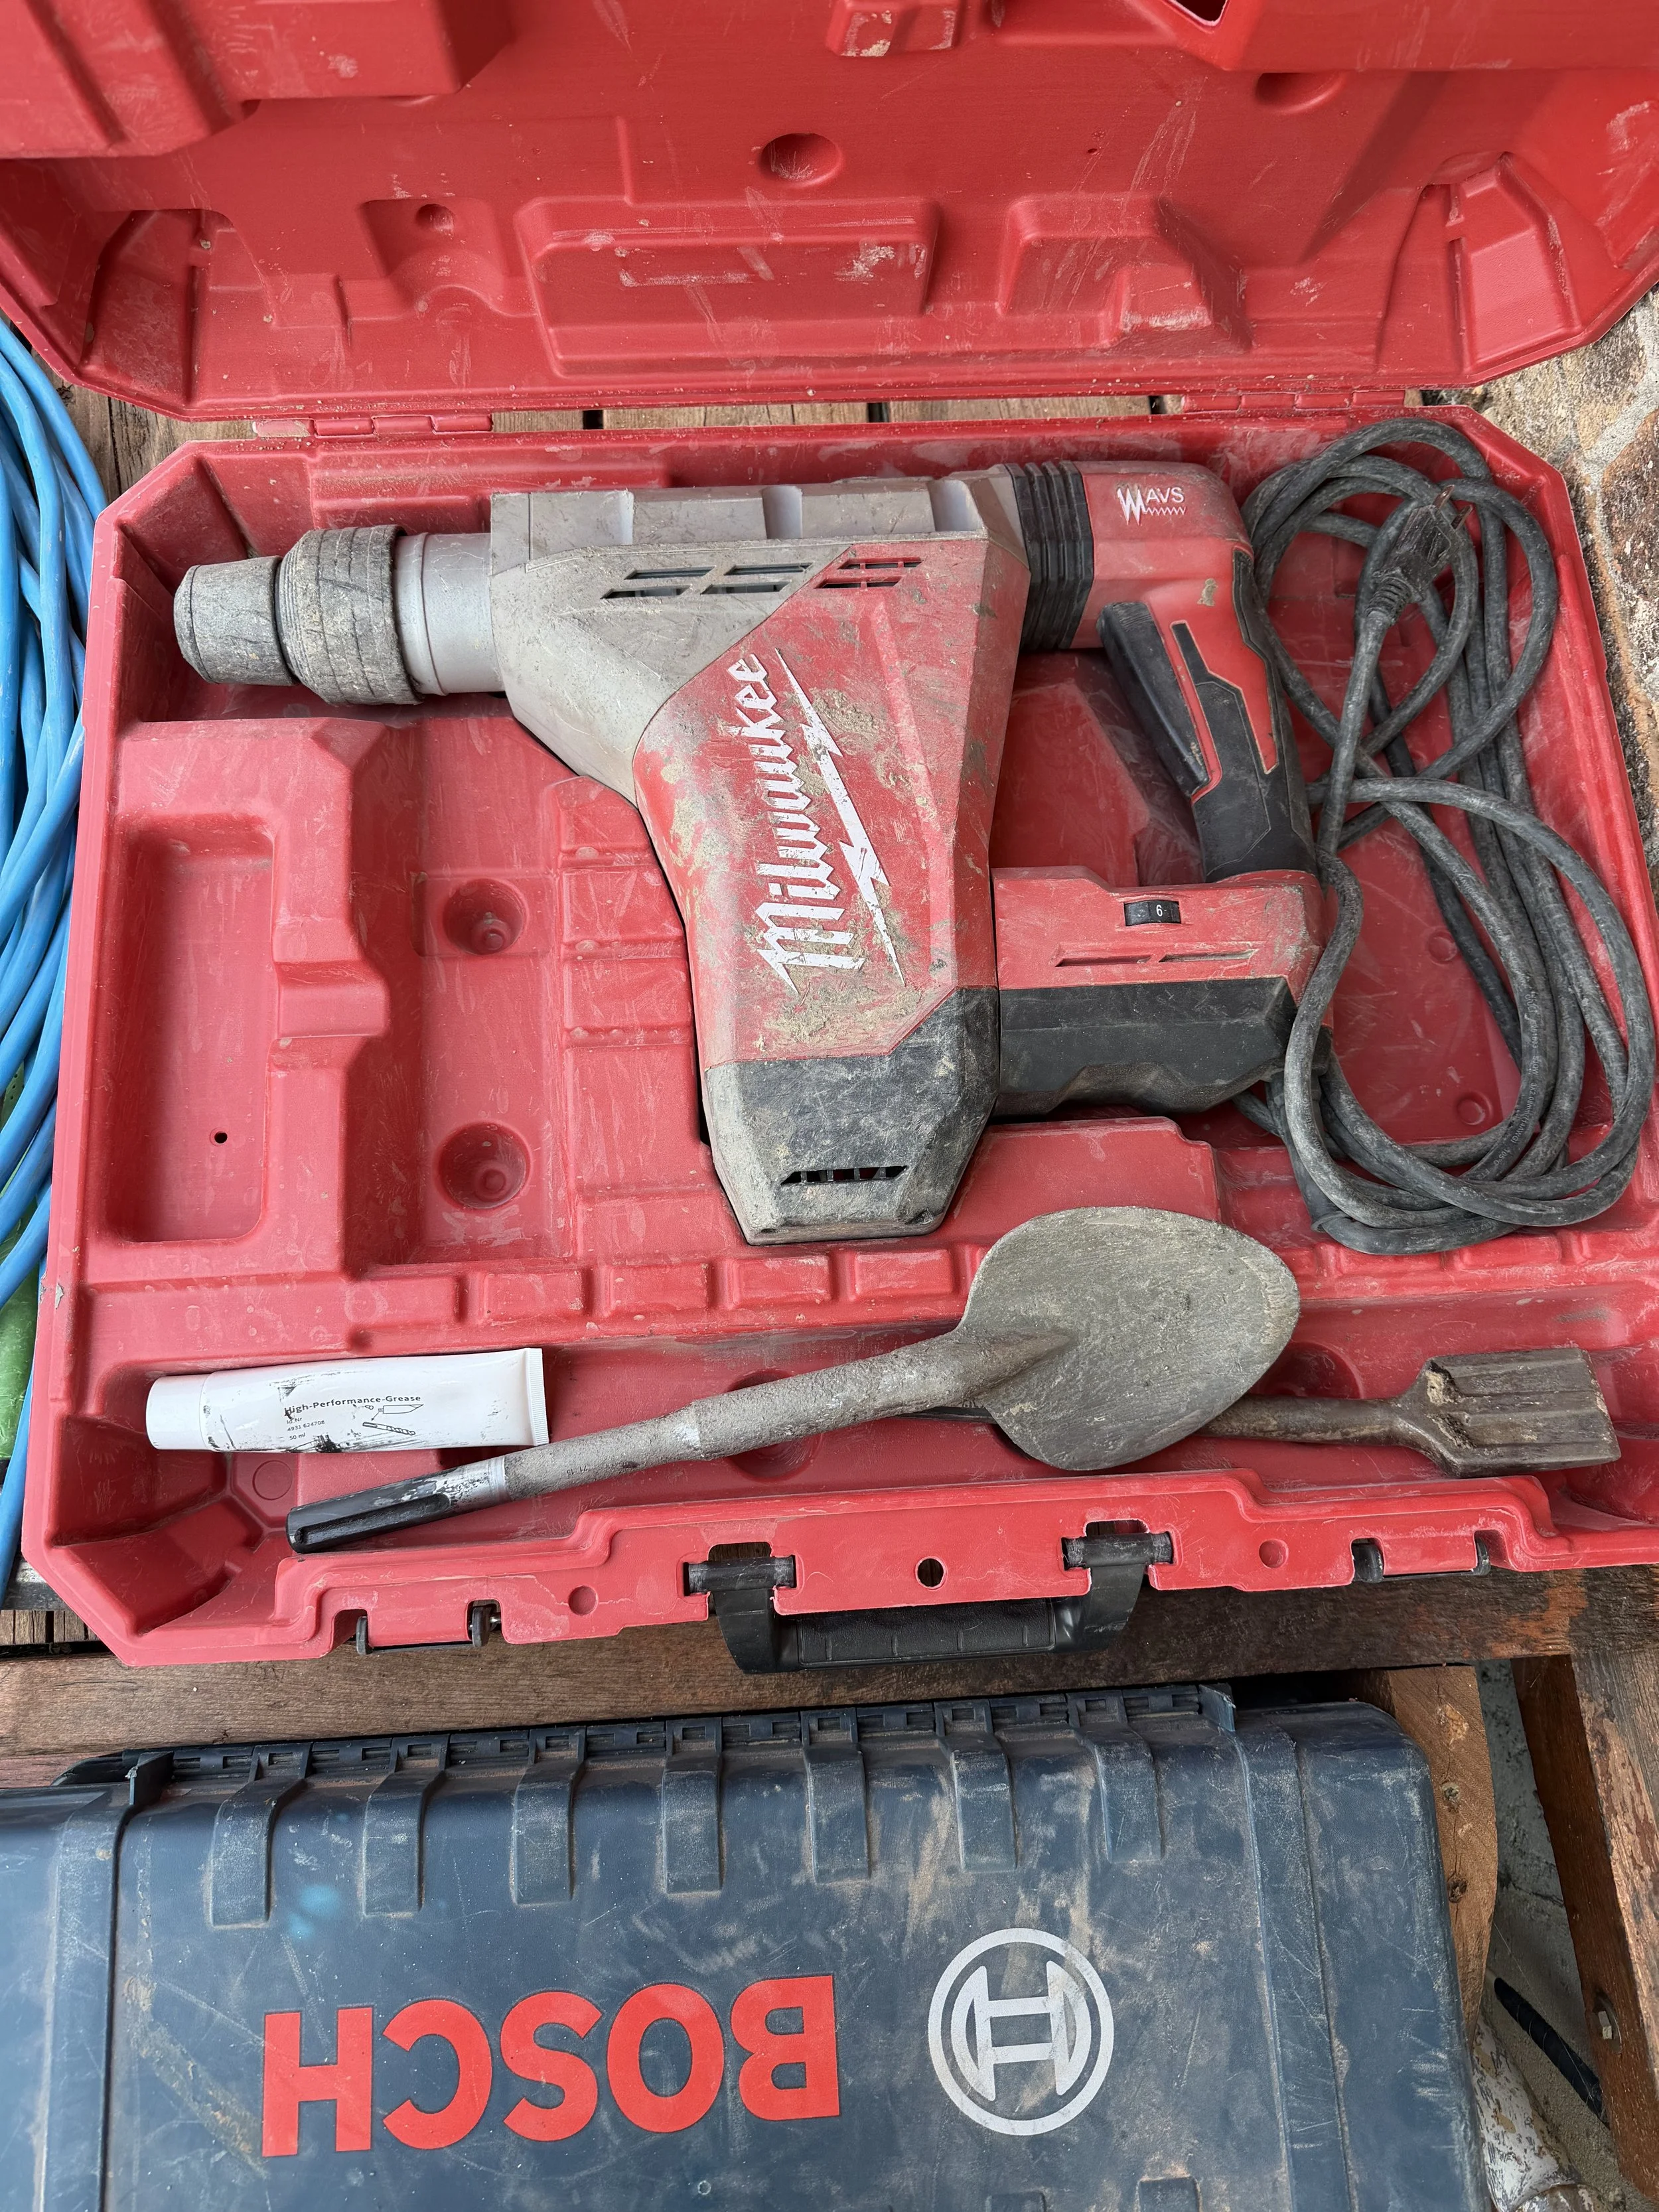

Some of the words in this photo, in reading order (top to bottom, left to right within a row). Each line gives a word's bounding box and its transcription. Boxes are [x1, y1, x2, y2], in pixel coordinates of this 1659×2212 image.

[722, 653, 865, 995] Milwaukee
[1156, 904, 1163, 917] 6
[284, 1395, 421, 1414] High-Performance-Grease
[303, 1420, 326, 1428] 624708
[262, 1974, 841, 2158] BOSCH
